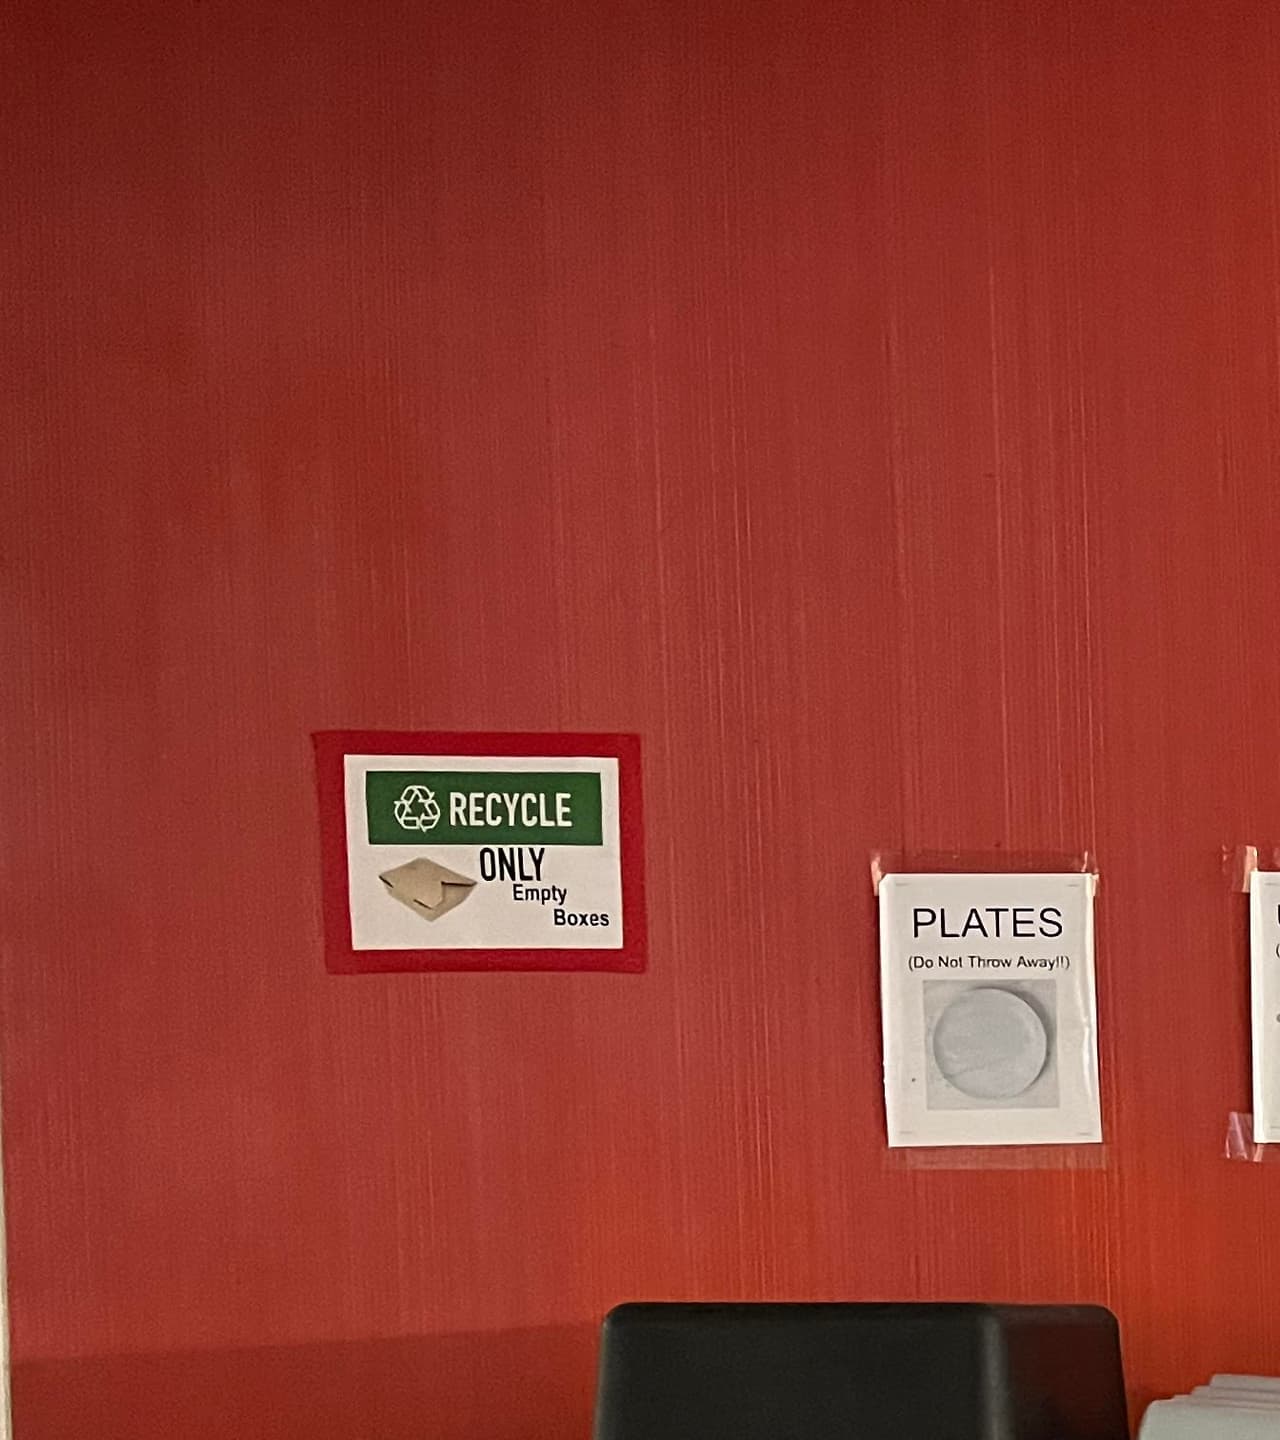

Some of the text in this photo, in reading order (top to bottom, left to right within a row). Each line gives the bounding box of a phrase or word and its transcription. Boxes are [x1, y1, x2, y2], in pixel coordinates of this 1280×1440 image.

[450, 792, 573, 827] RECYCLE
[479, 847, 545, 882] ONLY
[513, 884, 567, 906] Empty
[553, 909, 610, 927] Boxes
[913, 907, 1063, 938] PLATES
[908, 955, 1071, 972] (Do Not Throw Away!!)
